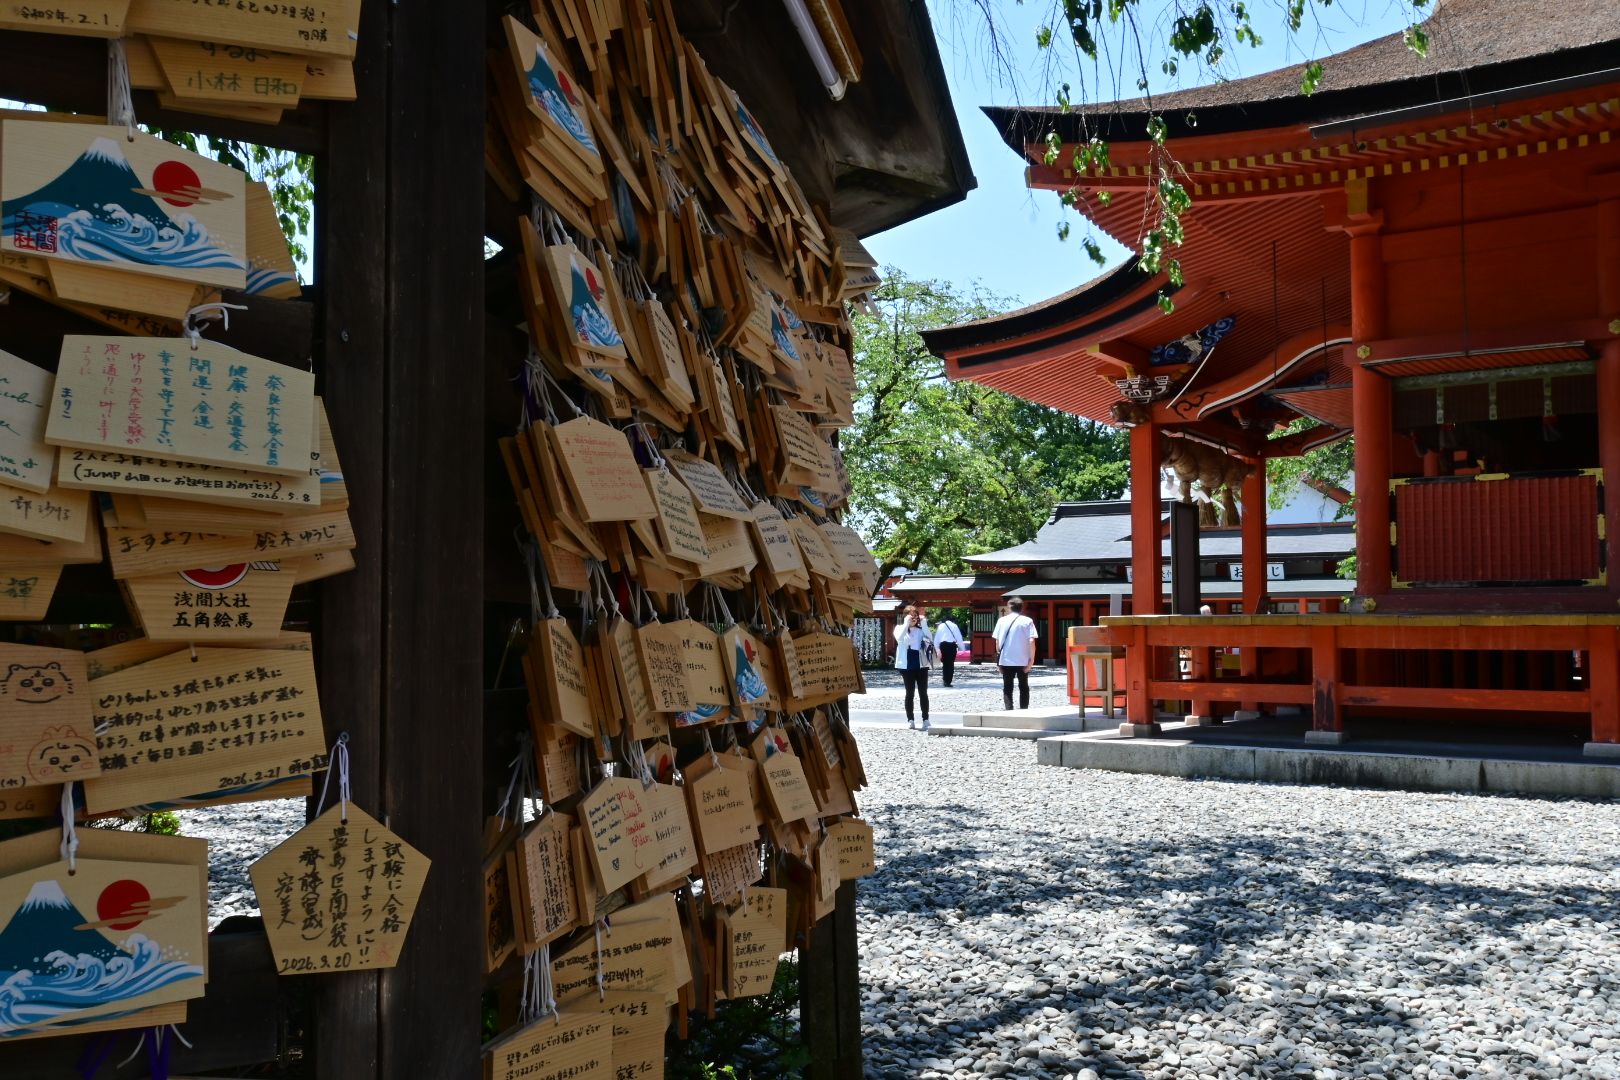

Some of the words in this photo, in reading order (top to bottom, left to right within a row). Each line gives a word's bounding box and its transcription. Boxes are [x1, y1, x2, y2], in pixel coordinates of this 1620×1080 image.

[188, 70, 241, 92] 小林
[254, 76, 297, 96] 日和
[1234, 565, 1281, 578] おじ
[174, 591, 251, 609] 浅間大社
[172, 611, 254, 629] 五角絵馬
[328, 827, 350, 948] 豊島区南池袋
[379, 841, 407, 934] 試験に合格
